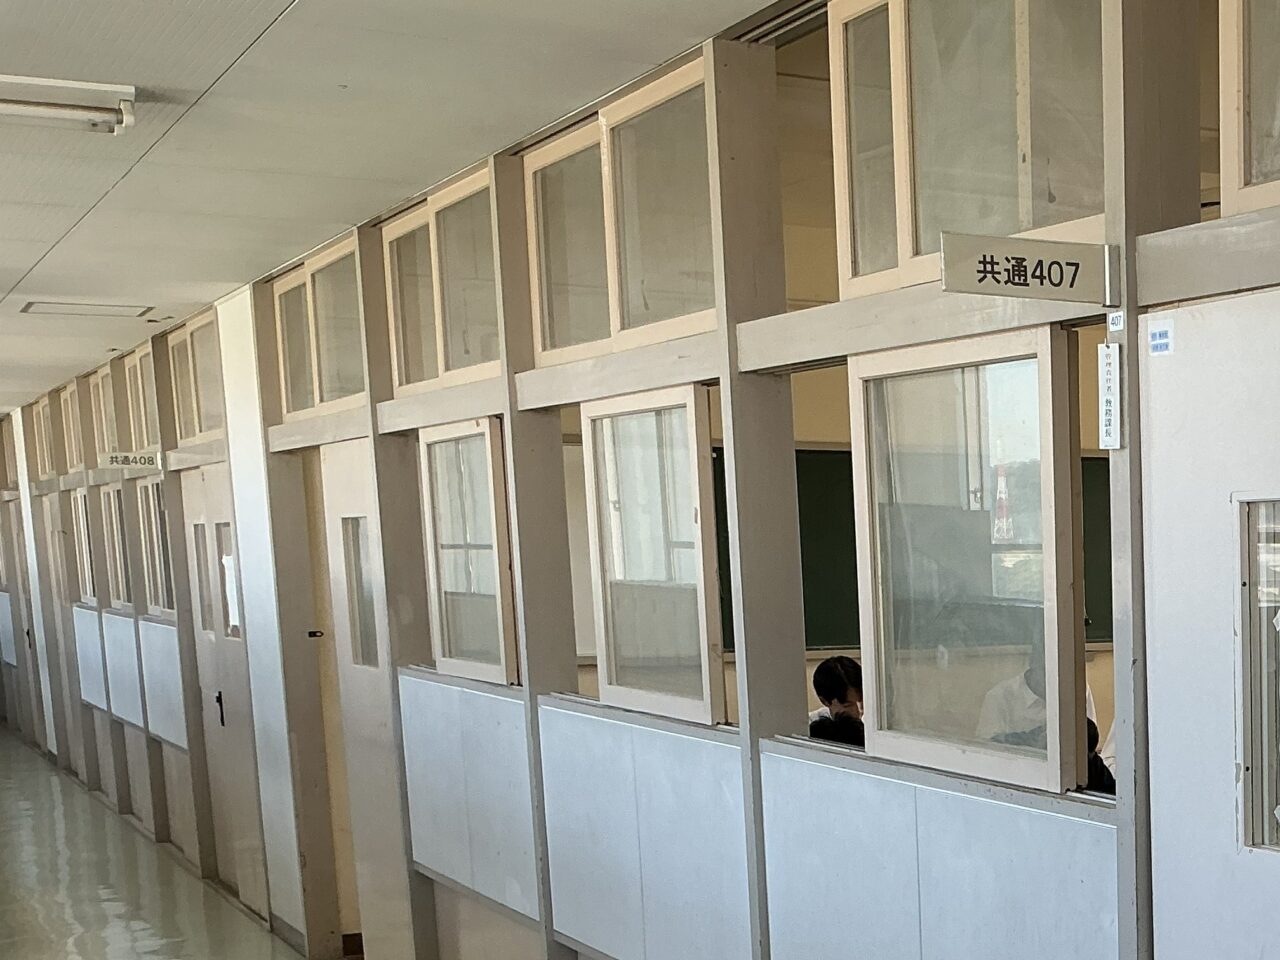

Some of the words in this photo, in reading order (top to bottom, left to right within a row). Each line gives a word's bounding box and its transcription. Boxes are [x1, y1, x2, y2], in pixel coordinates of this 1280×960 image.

[976, 254, 1080, 288] 共通407
[1110, 315, 1122, 328] 407
[110, 455, 155, 465] 共通408
